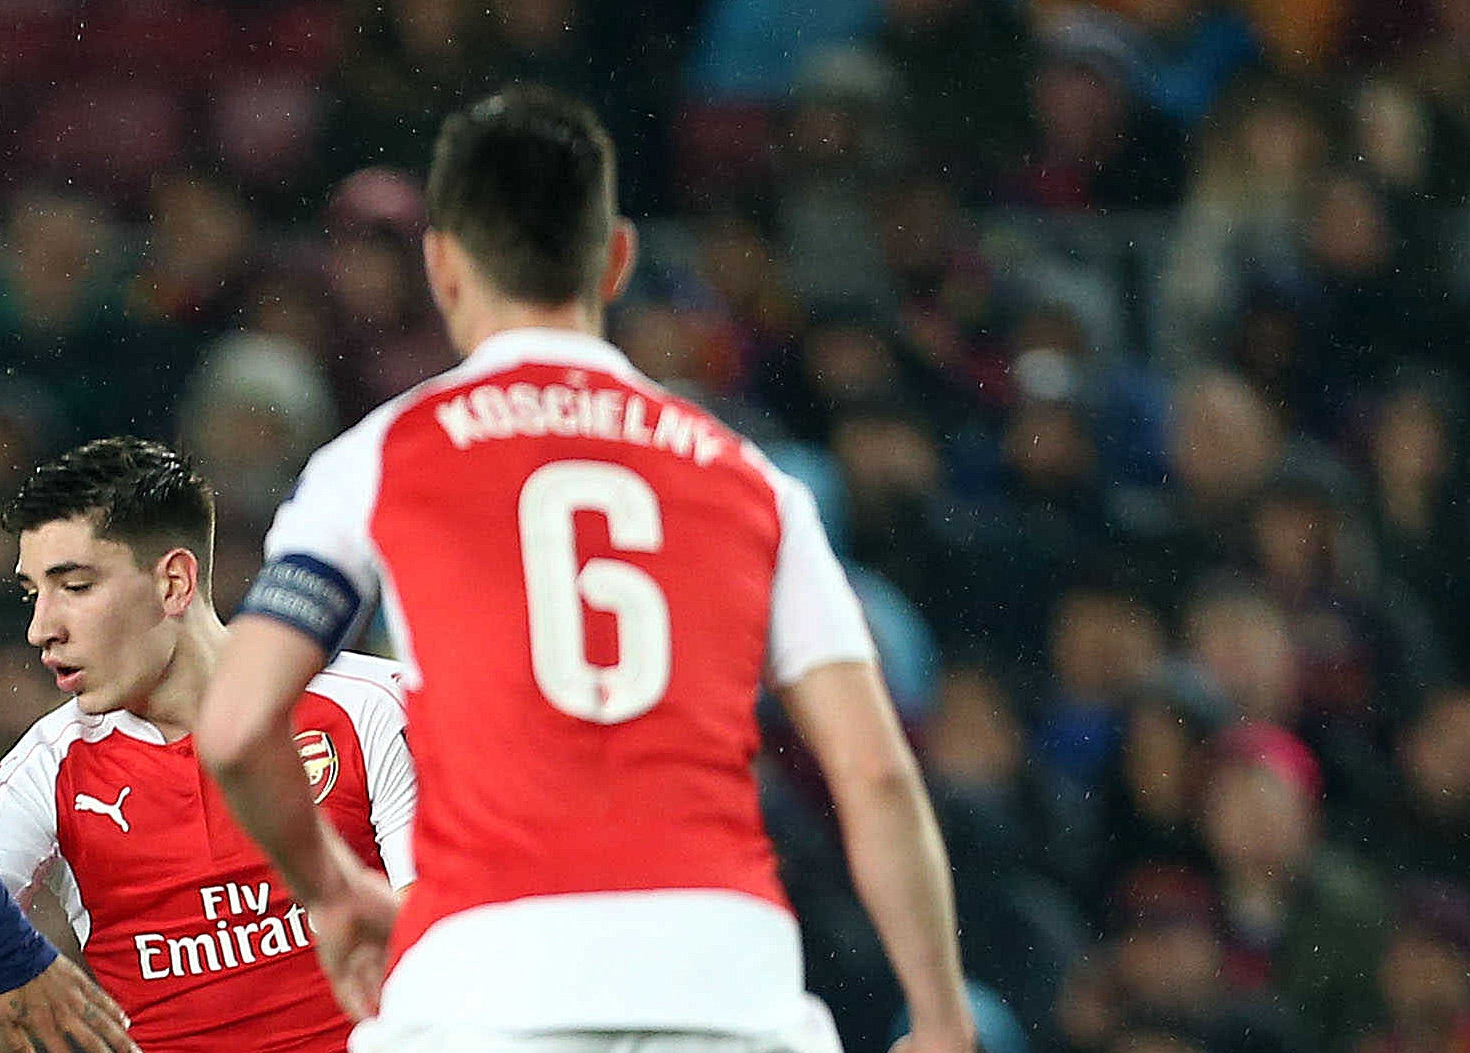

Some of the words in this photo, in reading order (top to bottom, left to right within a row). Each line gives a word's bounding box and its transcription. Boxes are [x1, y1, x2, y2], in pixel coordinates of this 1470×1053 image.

[435, 382, 721, 467] KOSCIELNY
[518, 459, 671, 725] 6
[200, 882, 270, 921] Fly
[134, 904, 318, 980] Emirat
